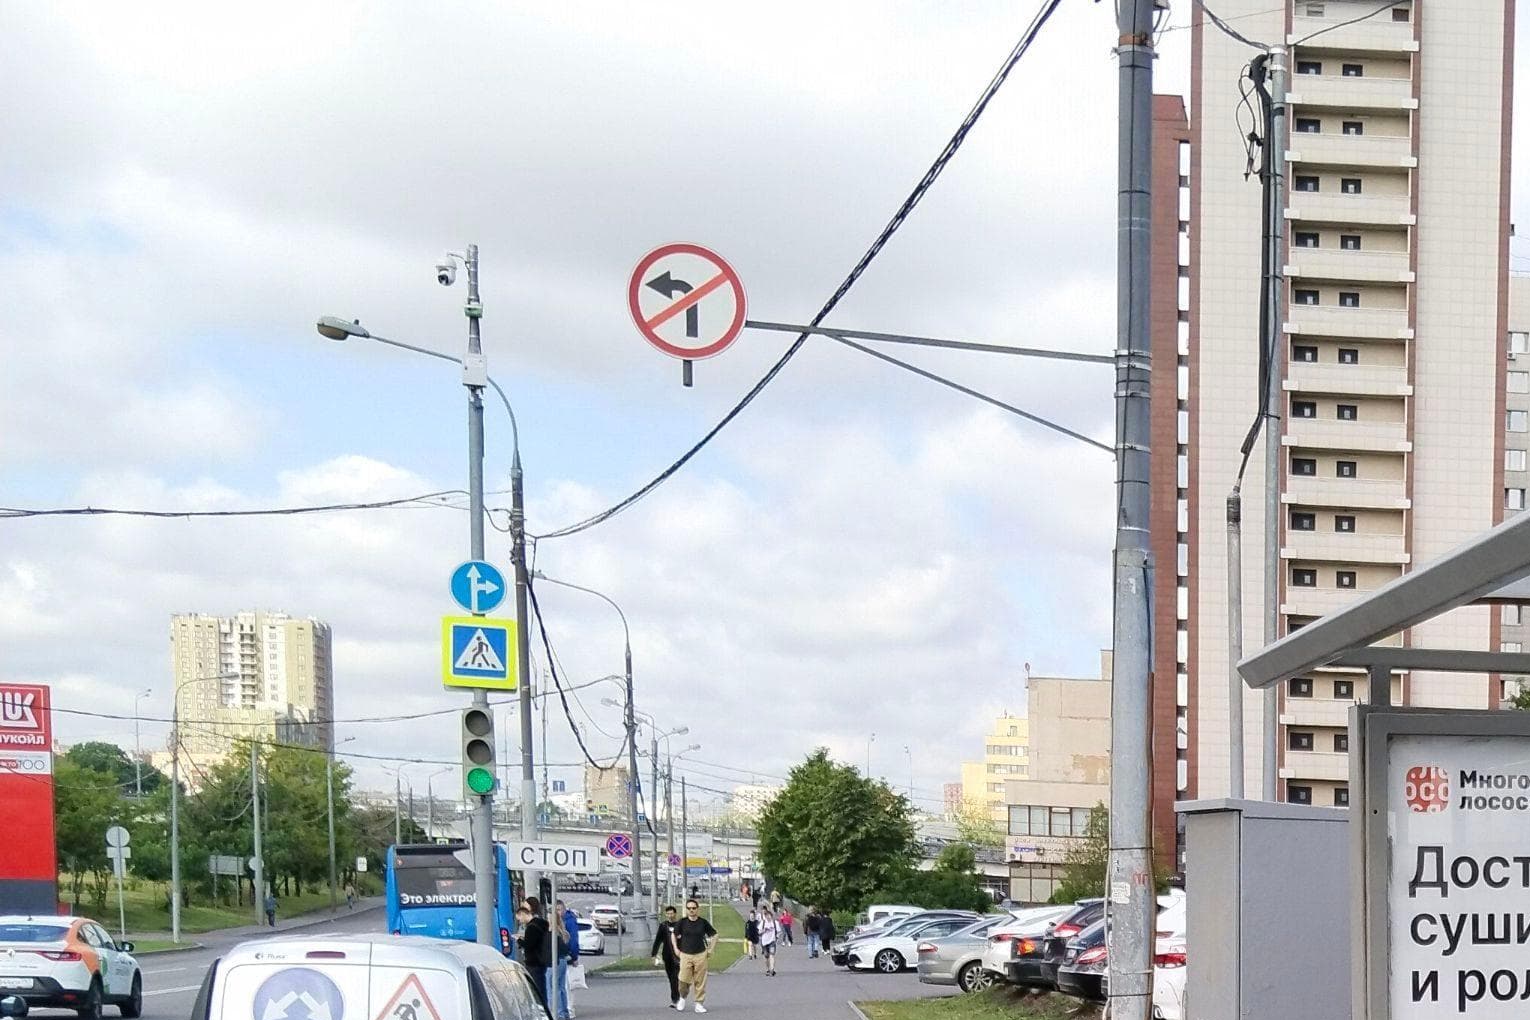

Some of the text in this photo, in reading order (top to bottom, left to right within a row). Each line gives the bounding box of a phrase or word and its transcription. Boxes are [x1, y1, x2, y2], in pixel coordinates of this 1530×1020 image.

[1459, 770, 1530, 789] Много
[521, 847, 587, 867] СТОП
[401, 893, 423, 905] Это
[1411, 970, 1439, 1002] и
